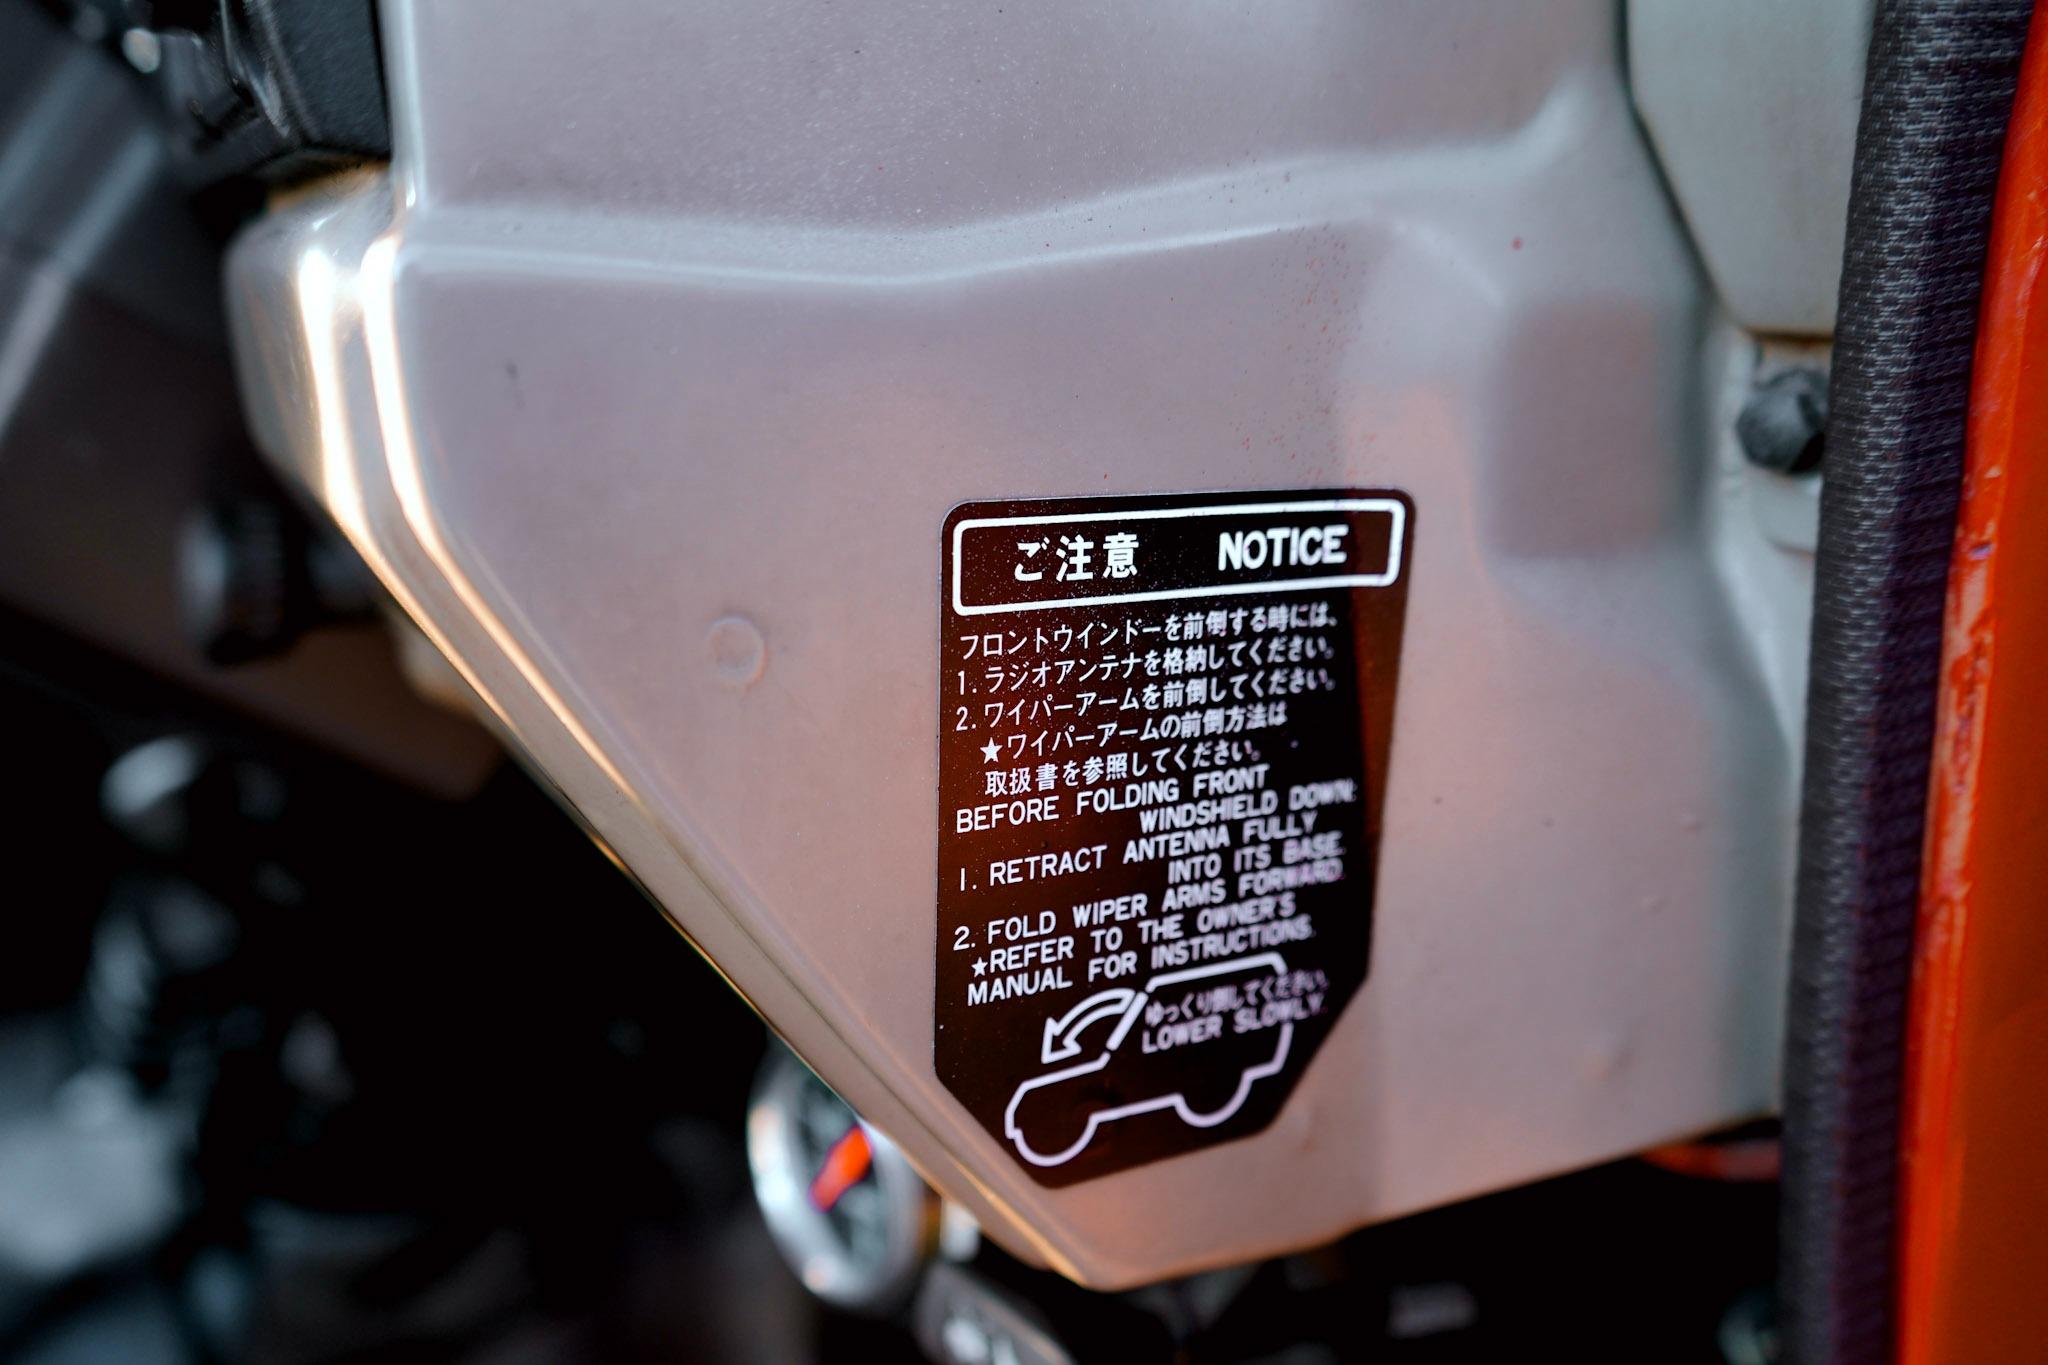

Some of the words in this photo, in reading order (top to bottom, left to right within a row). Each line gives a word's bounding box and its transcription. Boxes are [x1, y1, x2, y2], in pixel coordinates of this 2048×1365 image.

[1013, 532, 1139, 582] ご注意
[1218, 525, 1349, 571] NOTICE
[957, 670, 977, 696] 1.
[986, 636, 1334, 694] ラジオアンテナを格納してください。
[955, 705, 977, 732] 2.
[985, 737, 1260, 798] 取扱書を参照してください。
[956, 796, 1059, 833] BEFORE
[1077, 779, 1179, 816] FOLDING
[1193, 765, 1270, 801] FRONT
[1139, 790, 1278, 833] WINDSHIELD
[990, 845, 1108, 886] RETRACT
[1123, 824, 1230, 864] ANTENNA
[1242, 810, 1318, 843] FULLY
[1168, 854, 1221, 884] INTO
[1234, 843, 1272, 870] ITS
[954, 925, 975, 951] 2.
[988, 910, 1056, 945] FOLD
[1073, 892, 1148, 929] WIPER
[1162, 878, 1227, 912] ARMS
[1091, 925, 1123, 954] TO
[1138, 912, 1184, 943] THE
[1197, 892, 1296, 933] OWNER'S
[967, 969, 1072, 1006] MANUAL
[1088, 952, 1137, 982] FOR
[1142, 1015, 1223, 1054] LOWER
